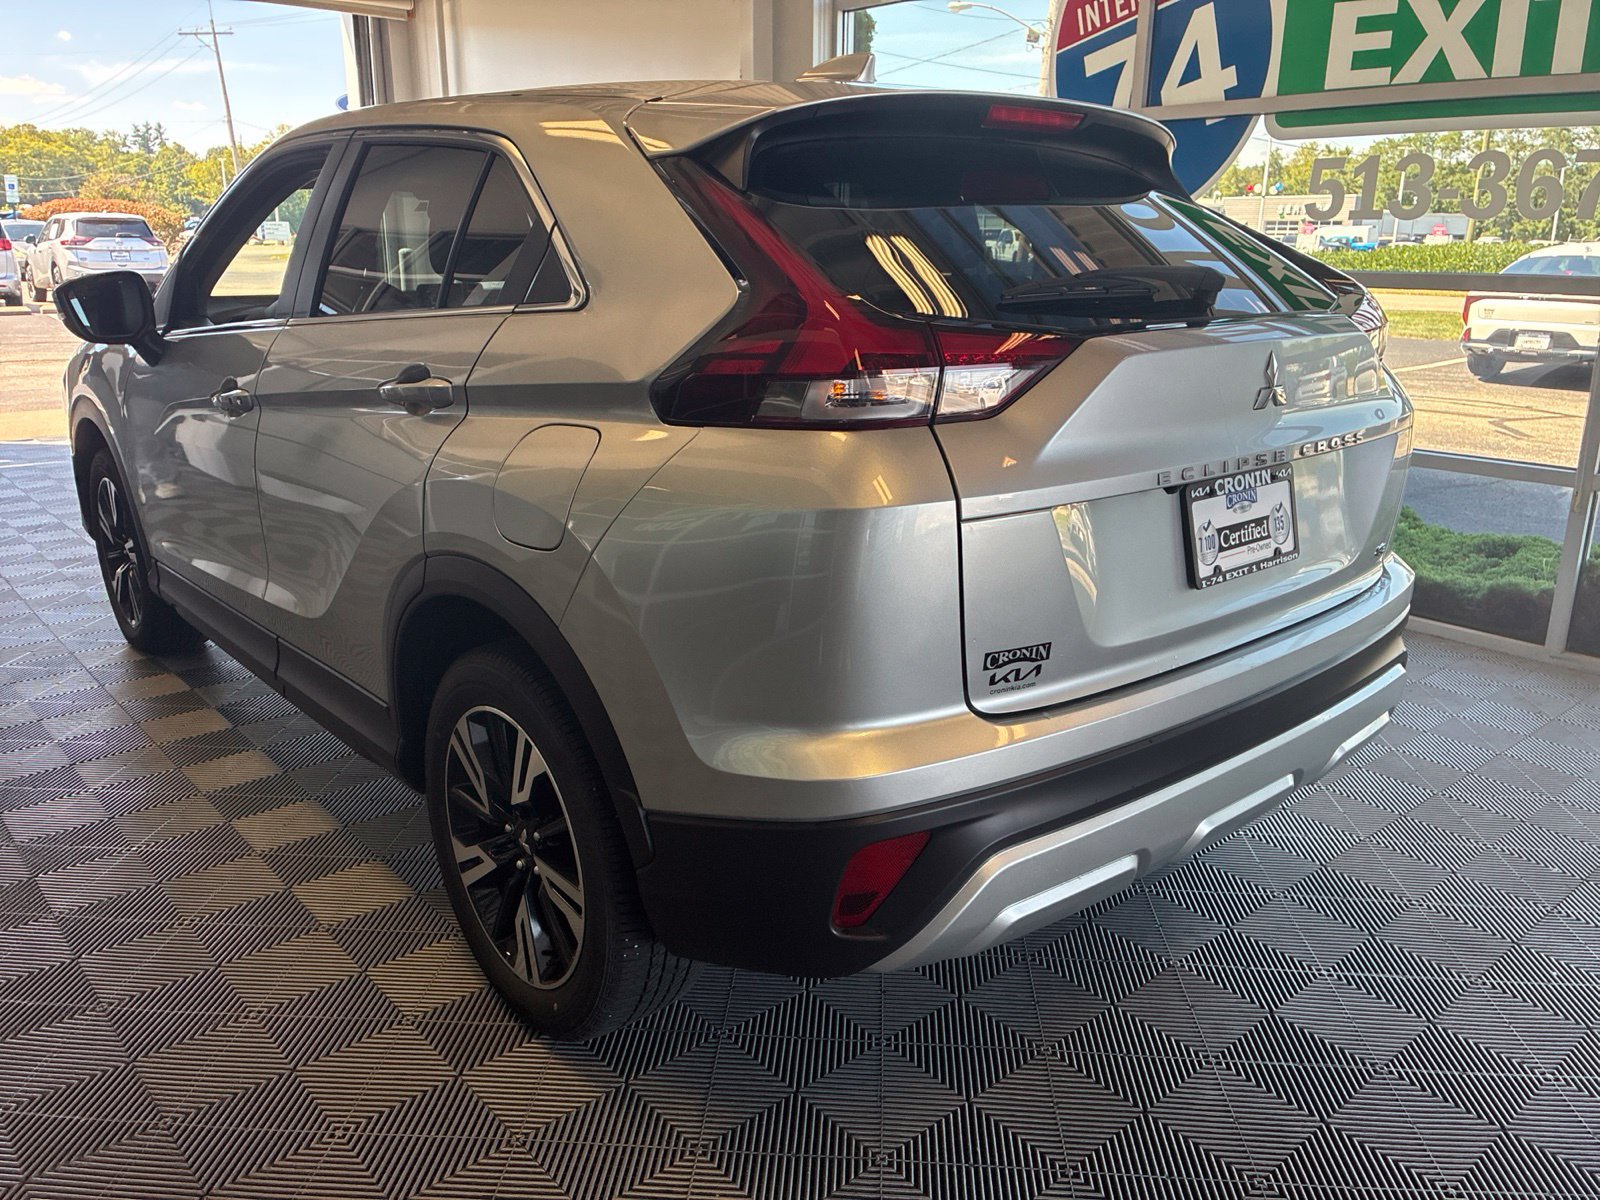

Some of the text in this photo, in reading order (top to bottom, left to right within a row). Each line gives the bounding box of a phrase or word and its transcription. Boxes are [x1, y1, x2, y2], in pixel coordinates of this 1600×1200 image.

[1084, 2, 1238, 118] 74
[1157, 430, 1366, 486] ECLIPSE CROSS
[1215, 469, 1271, 495] CRONIN
[1227, 489, 1257, 508] CRONIN
[1220, 520, 1268, 547] Certified
[1247, 541, 1272, 555] Pre-Owned
[1202, 552, 1298, 588] I-74 EXIT 1 Harrison
[986, 644, 1049, 669] CRONIN
[990, 682, 1037, 695] croninkia.com
